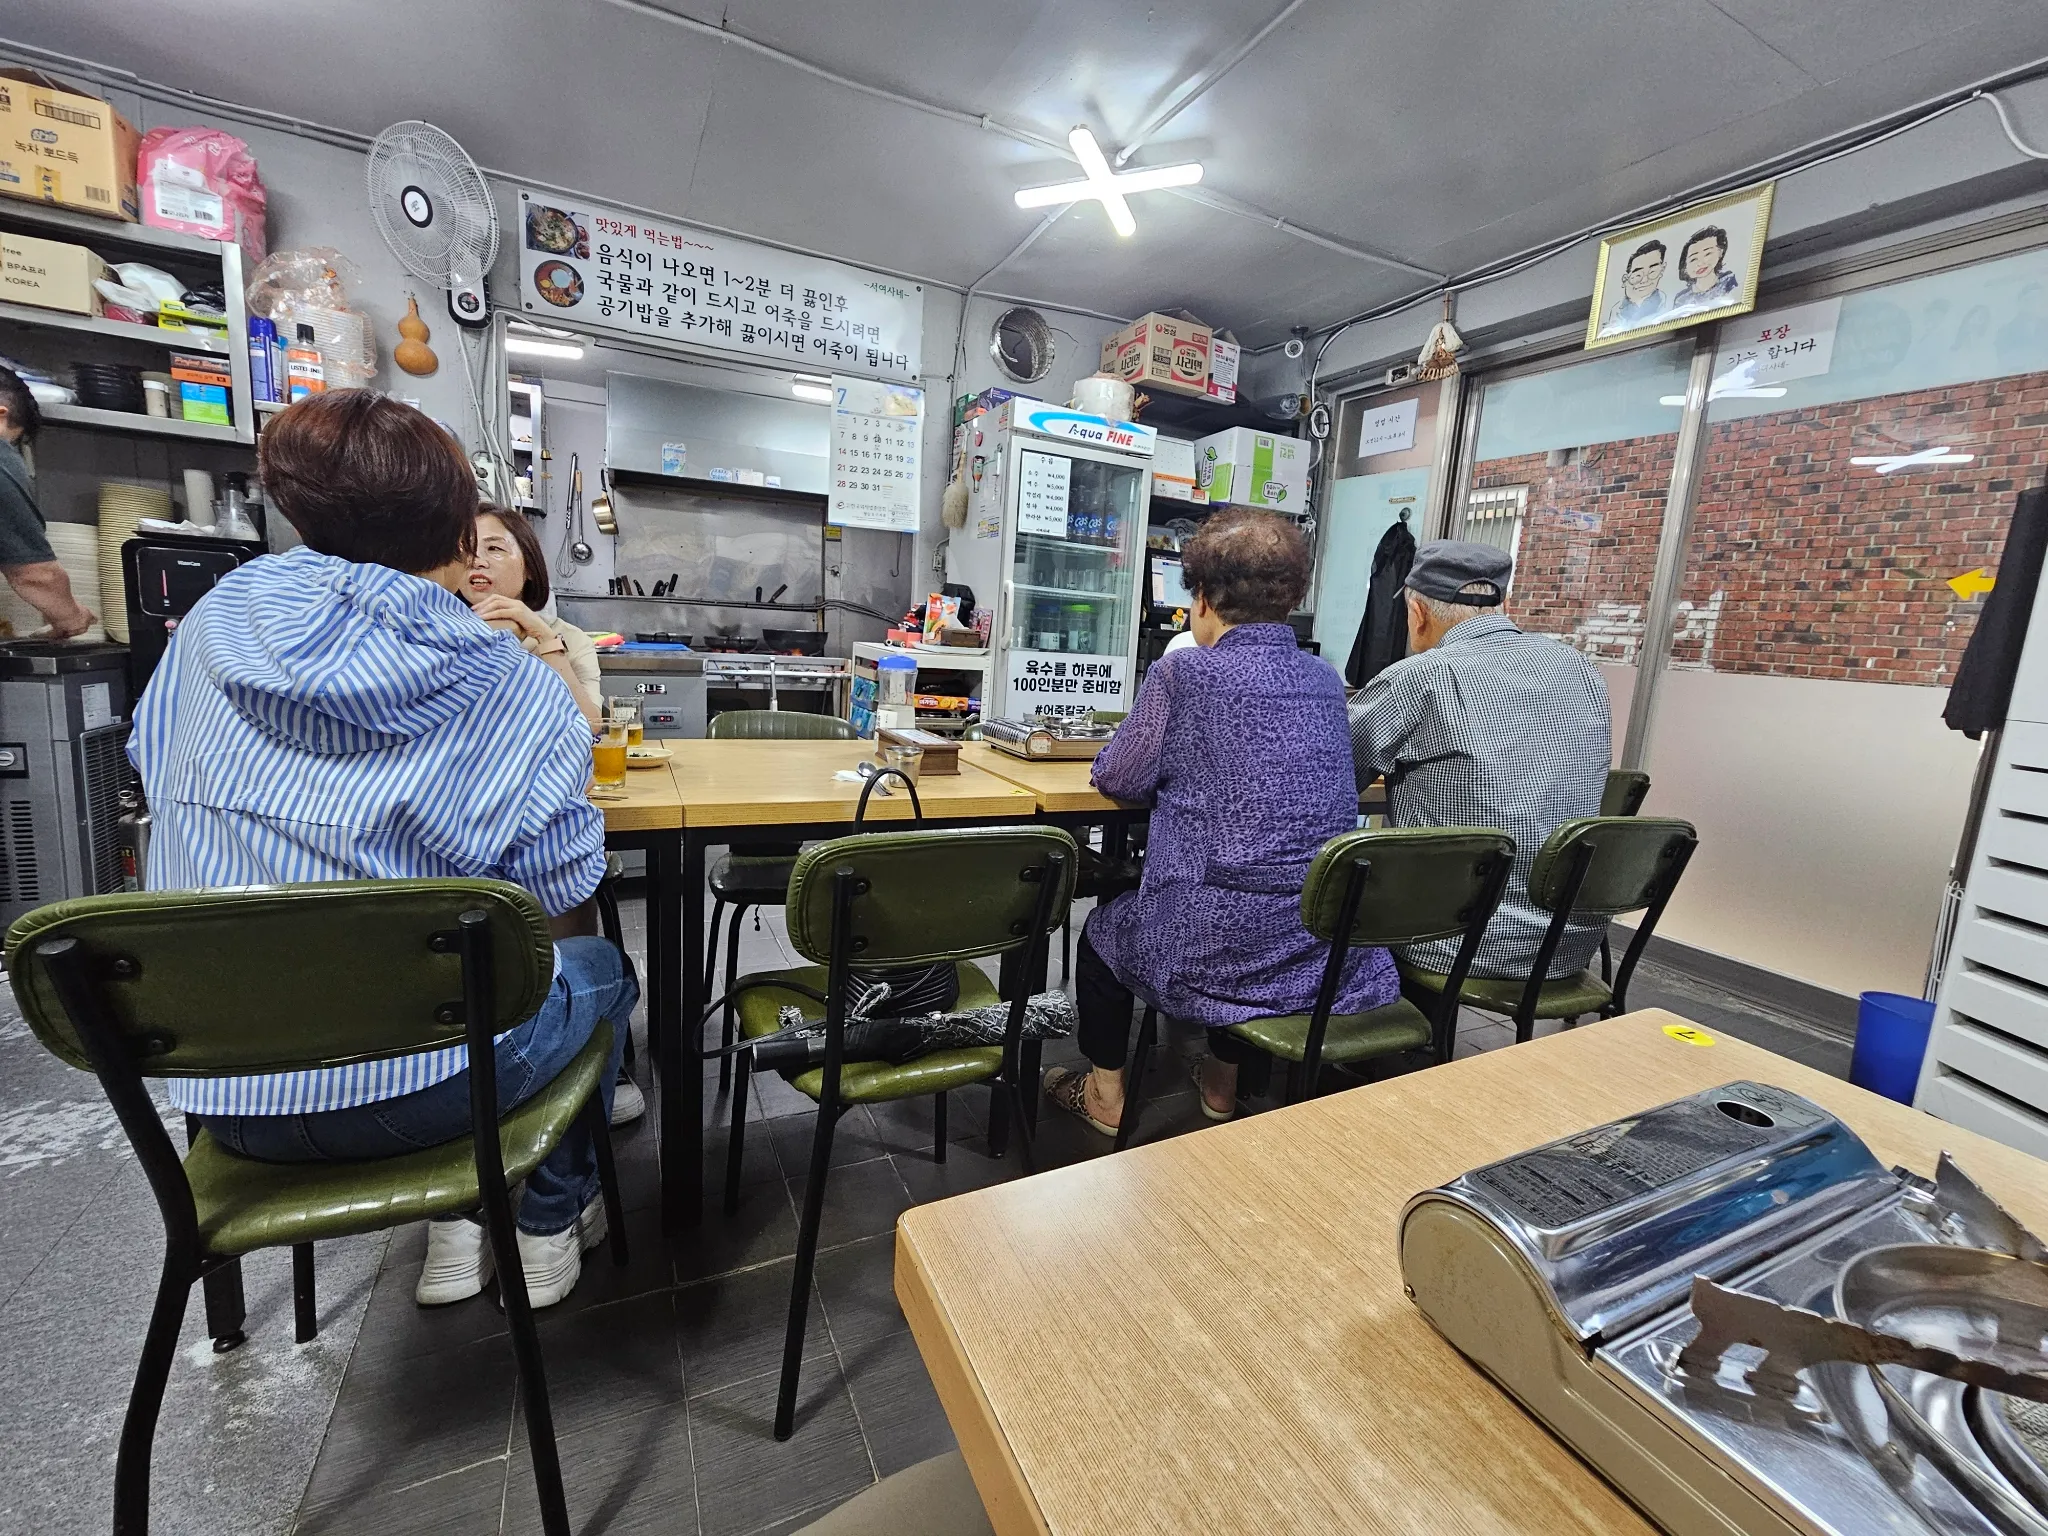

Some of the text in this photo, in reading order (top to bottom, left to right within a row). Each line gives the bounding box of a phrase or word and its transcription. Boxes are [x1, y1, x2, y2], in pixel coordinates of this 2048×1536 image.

[14, 140, 79, 164] 녹차 뽀드득
[596, 218, 636, 238] 맛있게
[7, 262, 46, 276] BPA프리
[596, 244, 848, 312] 음식이 나오면 1~2분 더 끓인후
[5, 276, 40, 288] KOREA
[596, 270, 880, 345] 국물과 같이 드시고 어죽을 드시려면
[597, 295, 909, 371] 공기밥을 추가해 끓이시면 어죽이 됩니다
[1757, 324, 1790, 342] 포장
[1768, 338, 1816, 360] 합니다
[1175, 356, 1202, 372] 사리면
[838, 388, 847, 404] 7
[1068, 424, 1134, 446] Aqua FINE
[838, 480, 846, 488] 28
[1026, 660, 1112, 678] 육수를 하루에
[1013, 678, 1121, 694] 100인분만 준비함
